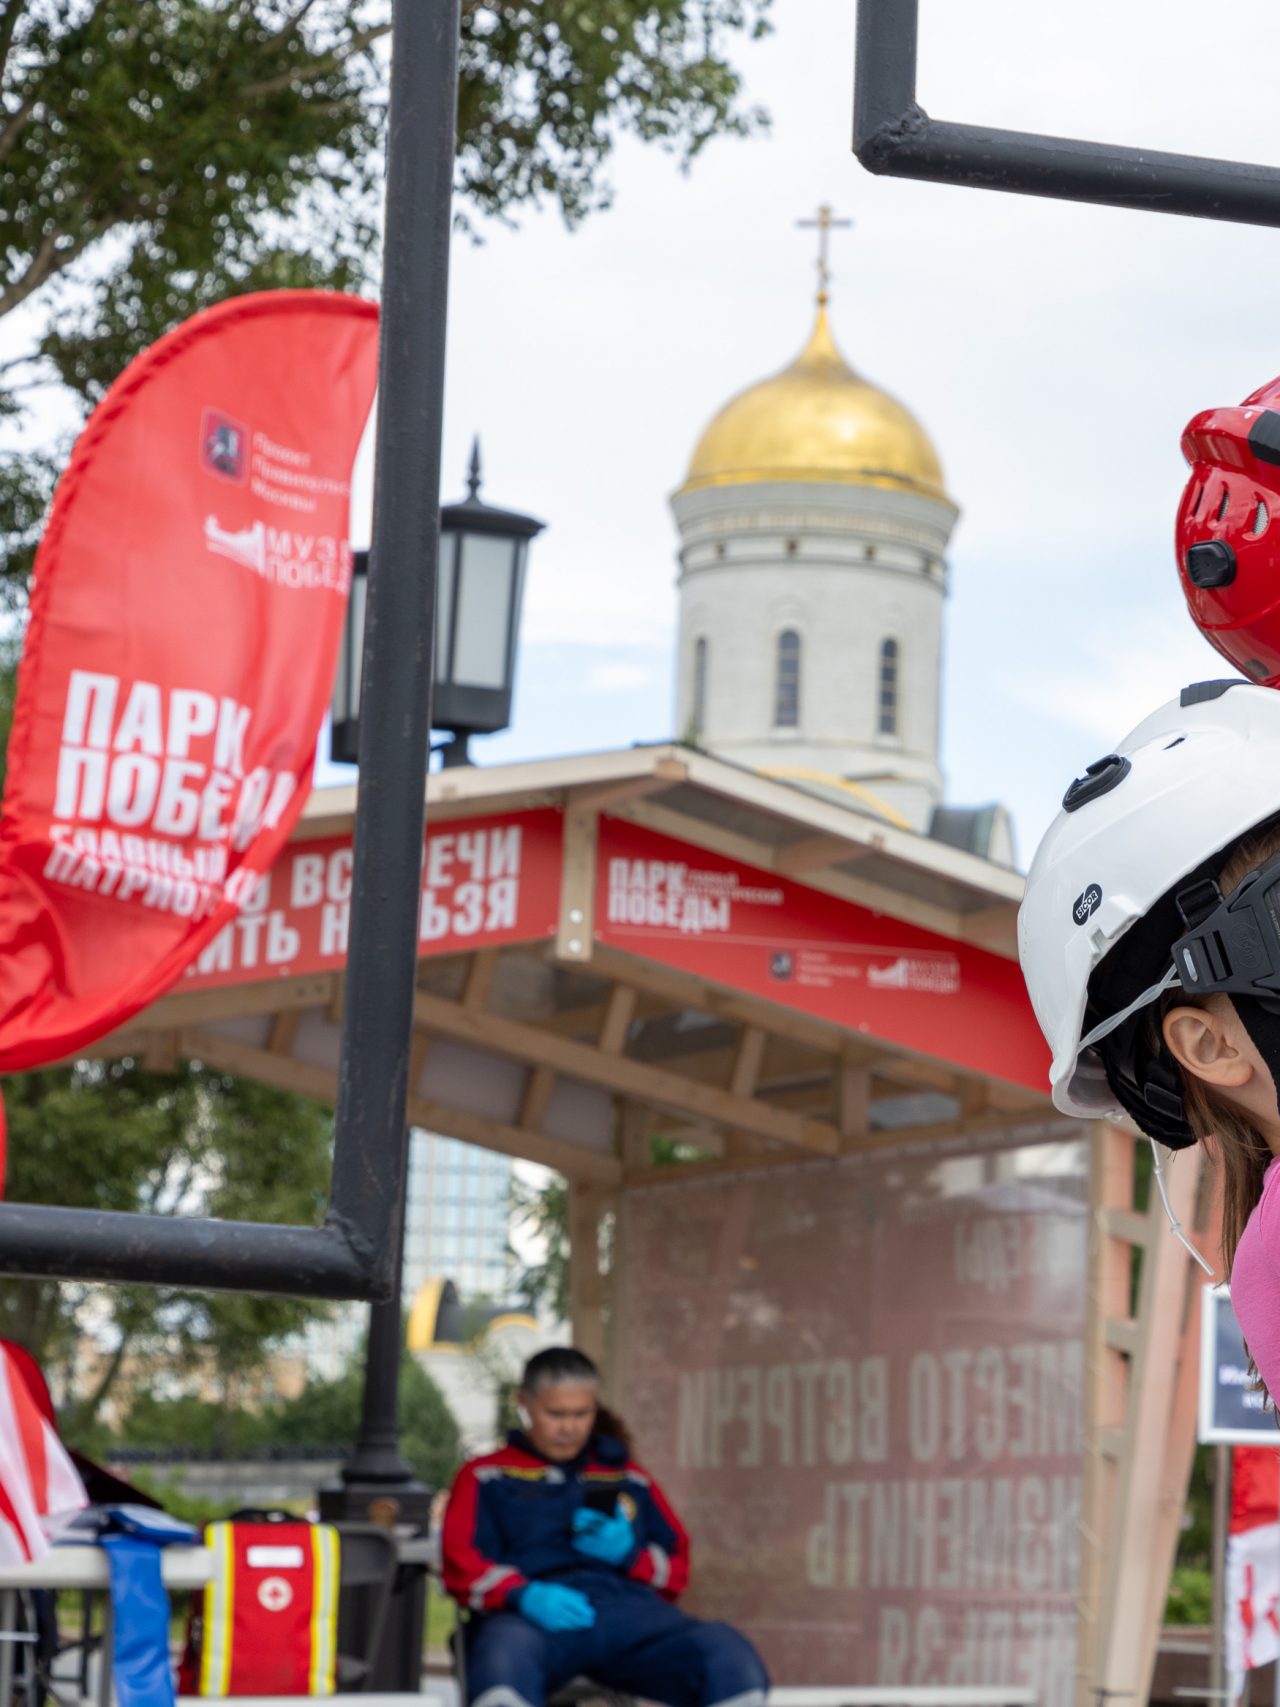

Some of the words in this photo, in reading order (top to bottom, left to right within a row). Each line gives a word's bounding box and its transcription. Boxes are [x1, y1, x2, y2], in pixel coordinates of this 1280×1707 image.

[62, 669, 252, 779] ПАРК
[608, 857, 686, 894] ПАРК
[607, 892, 731, 935] ПОБЕДЫ
[1076, 891, 1099, 918] SICOR
